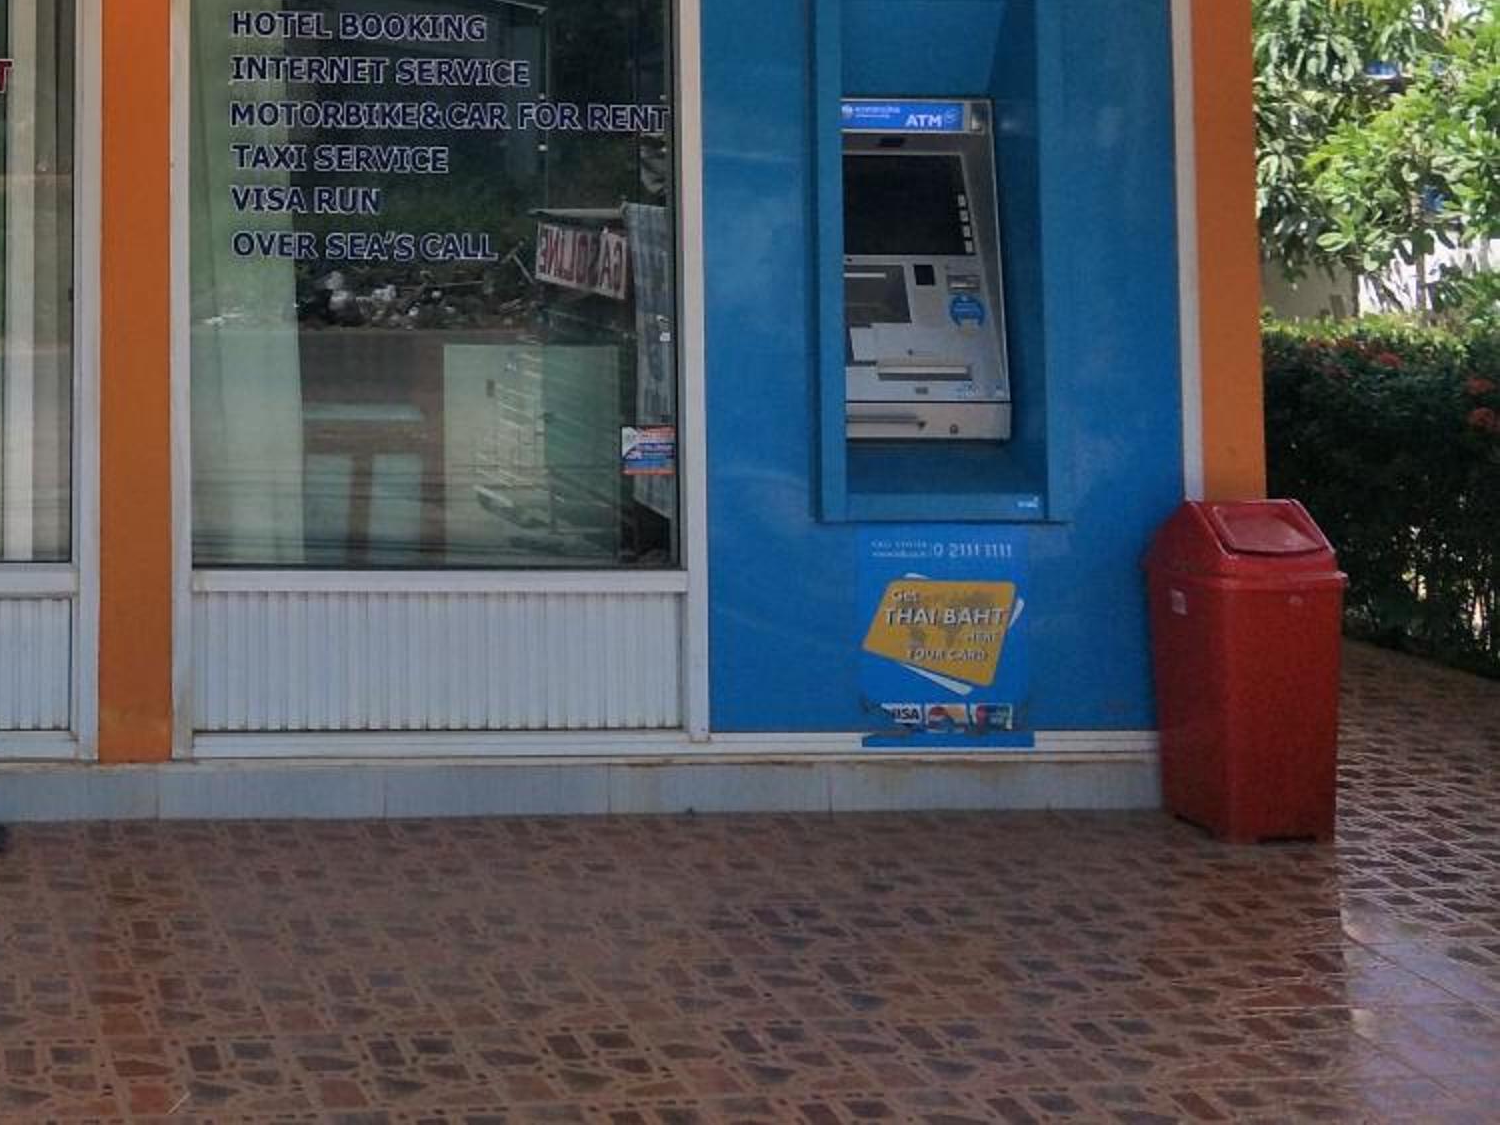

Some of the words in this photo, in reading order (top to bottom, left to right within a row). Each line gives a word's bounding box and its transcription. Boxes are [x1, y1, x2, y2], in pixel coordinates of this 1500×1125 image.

[231, 11, 332, 40] HOTEL
[339, 13, 488, 42] BOOKING
[230, 56, 389, 85] INTERNET
[395, 58, 531, 87] SERVICE
[517, 102, 582, 132] FOR
[587, 104, 669, 133] RENT
[905, 113, 943, 128] ATM
[231, 143, 307, 173] TAXI
[314, 145, 449, 174] SERVICE
[230, 186, 308, 214] VISA
[314, 186, 381, 215] RUN
[231, 232, 318, 260] OVER
[419, 233, 500, 261] CALL
[885, 607, 936, 626] THAI
[943, 607, 1006, 626] BAHT
